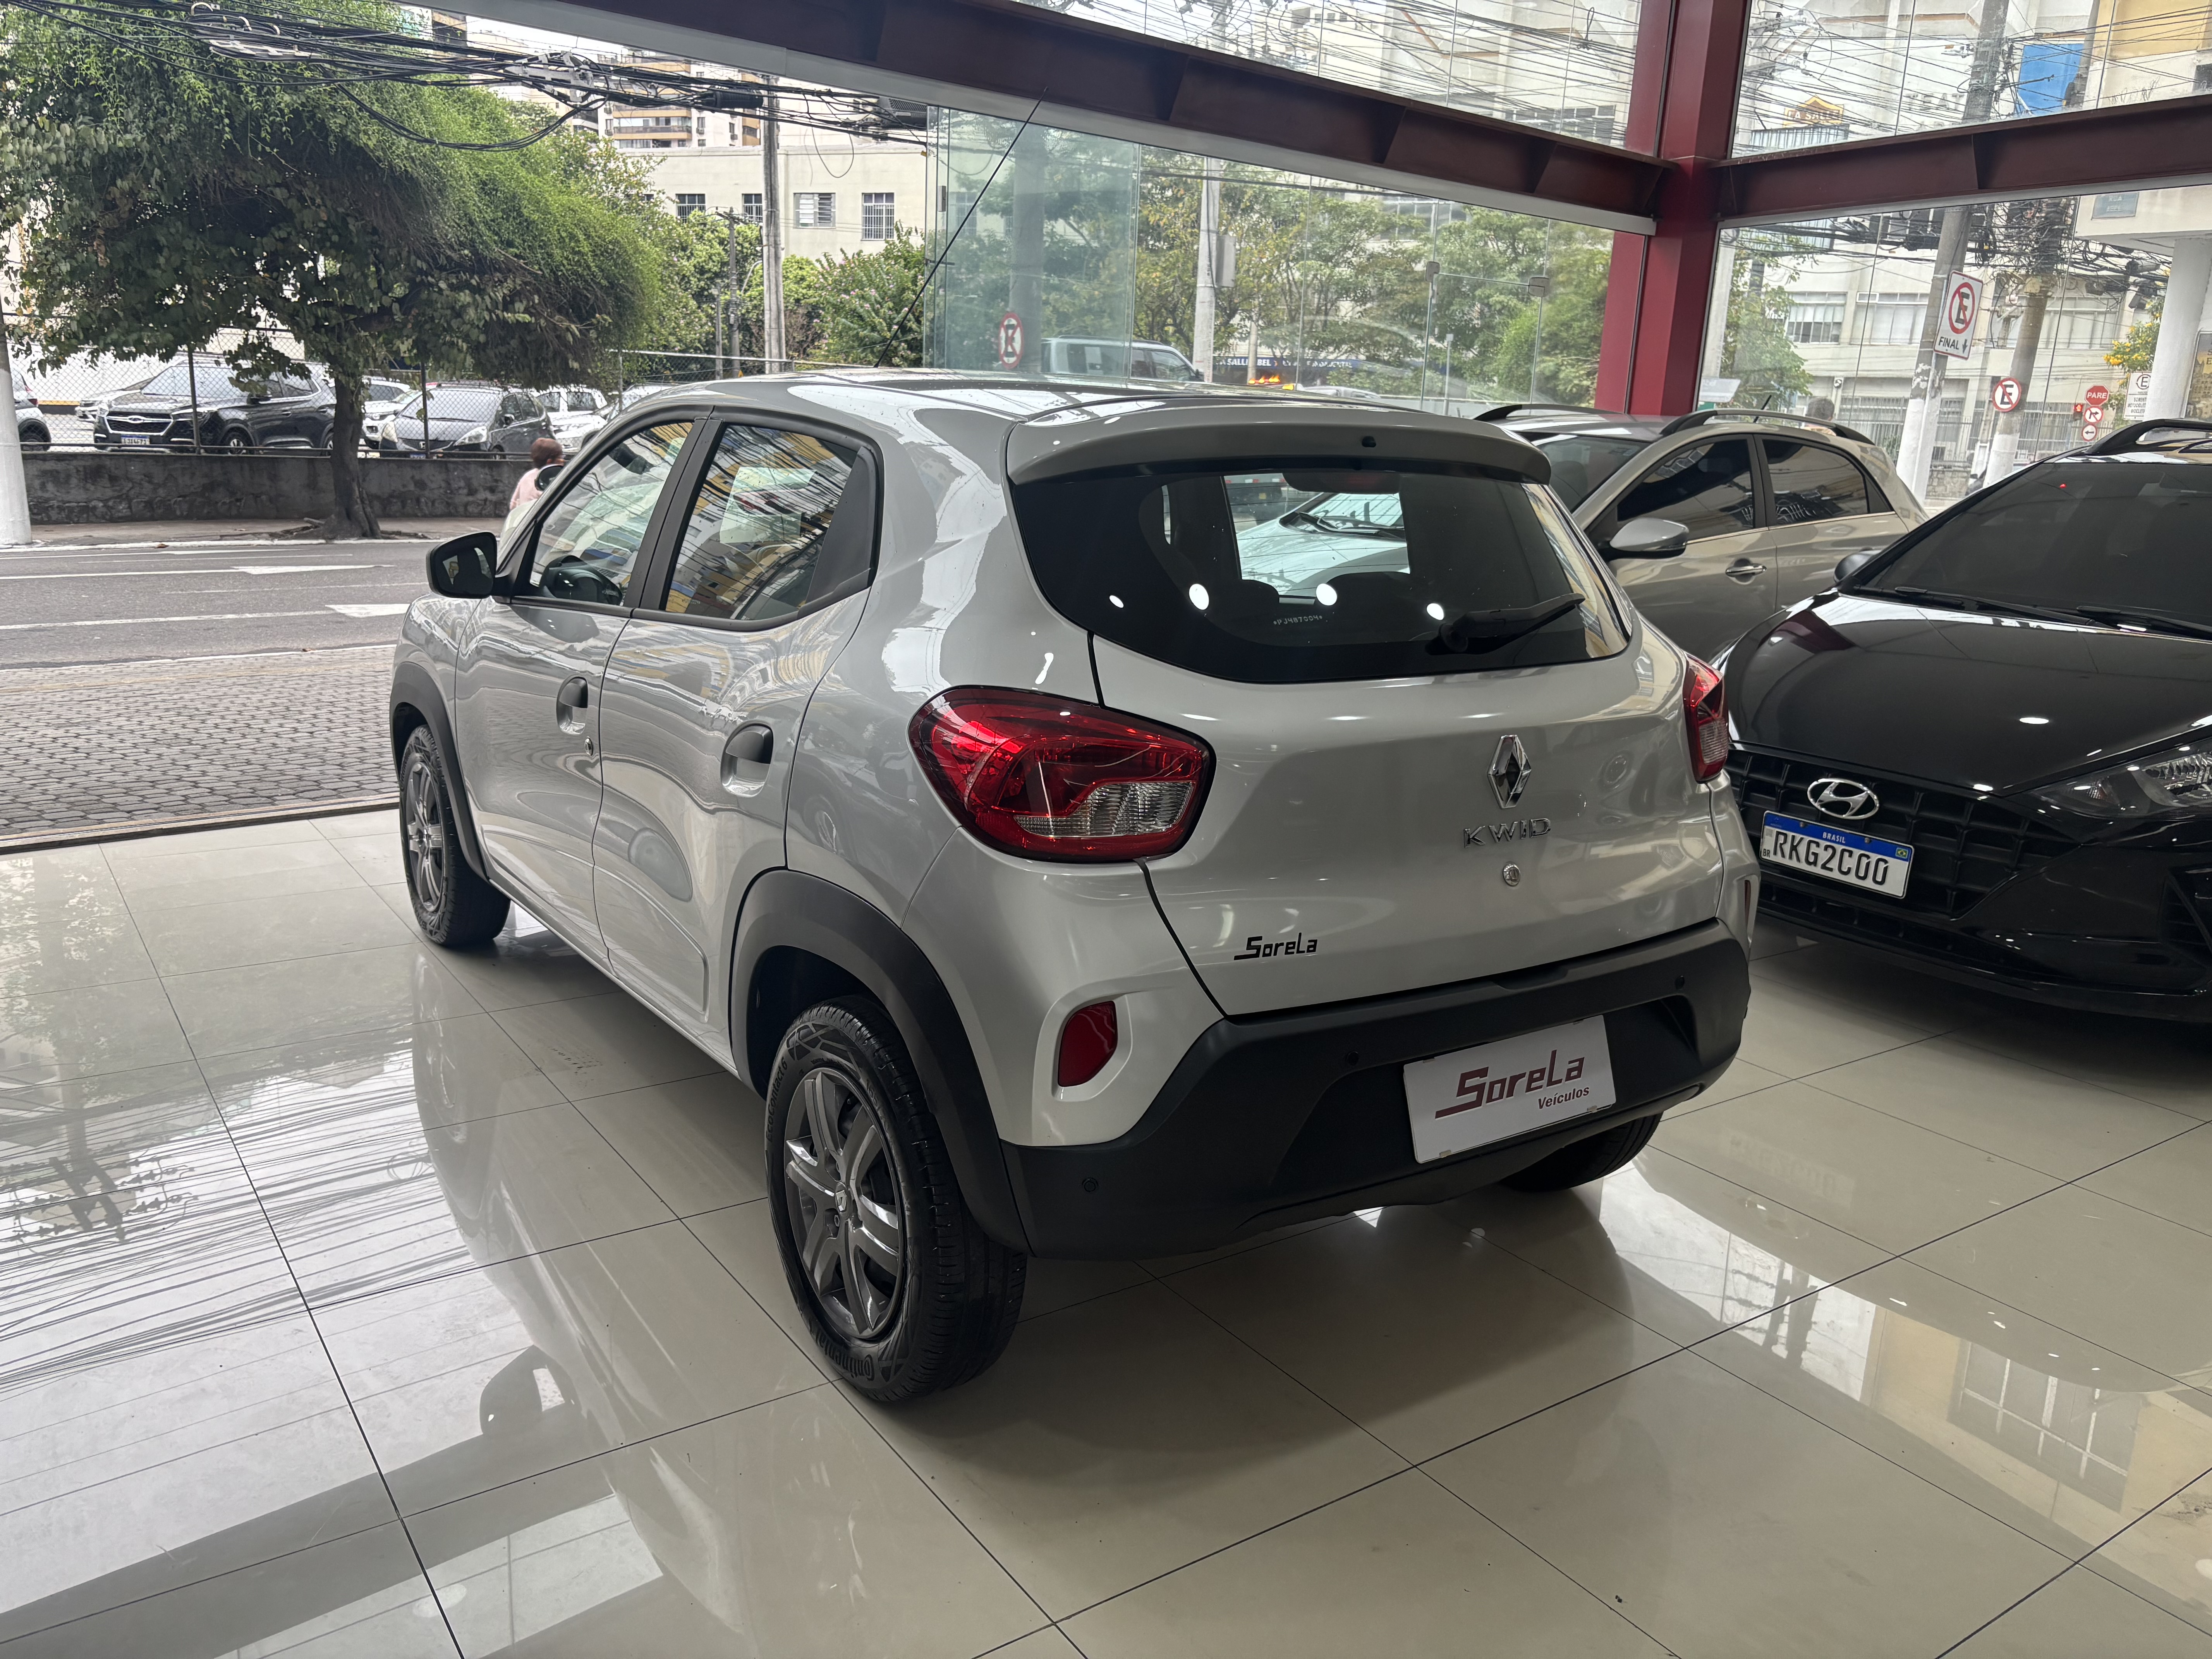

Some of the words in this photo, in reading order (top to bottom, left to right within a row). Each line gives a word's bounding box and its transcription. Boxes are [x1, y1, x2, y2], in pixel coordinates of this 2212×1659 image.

[1905, 93, 1965, 110] TEAT
[1939, 337, 1959, 350] FINAL
[1464, 818, 1552, 848] KWID
[1822, 832, 1846, 843] BRASIL
[1763, 848, 1771, 858] BR
[1773, 831, 1889, 886] RKG2C00
[1538, 1086, 1590, 1109] Veículos
